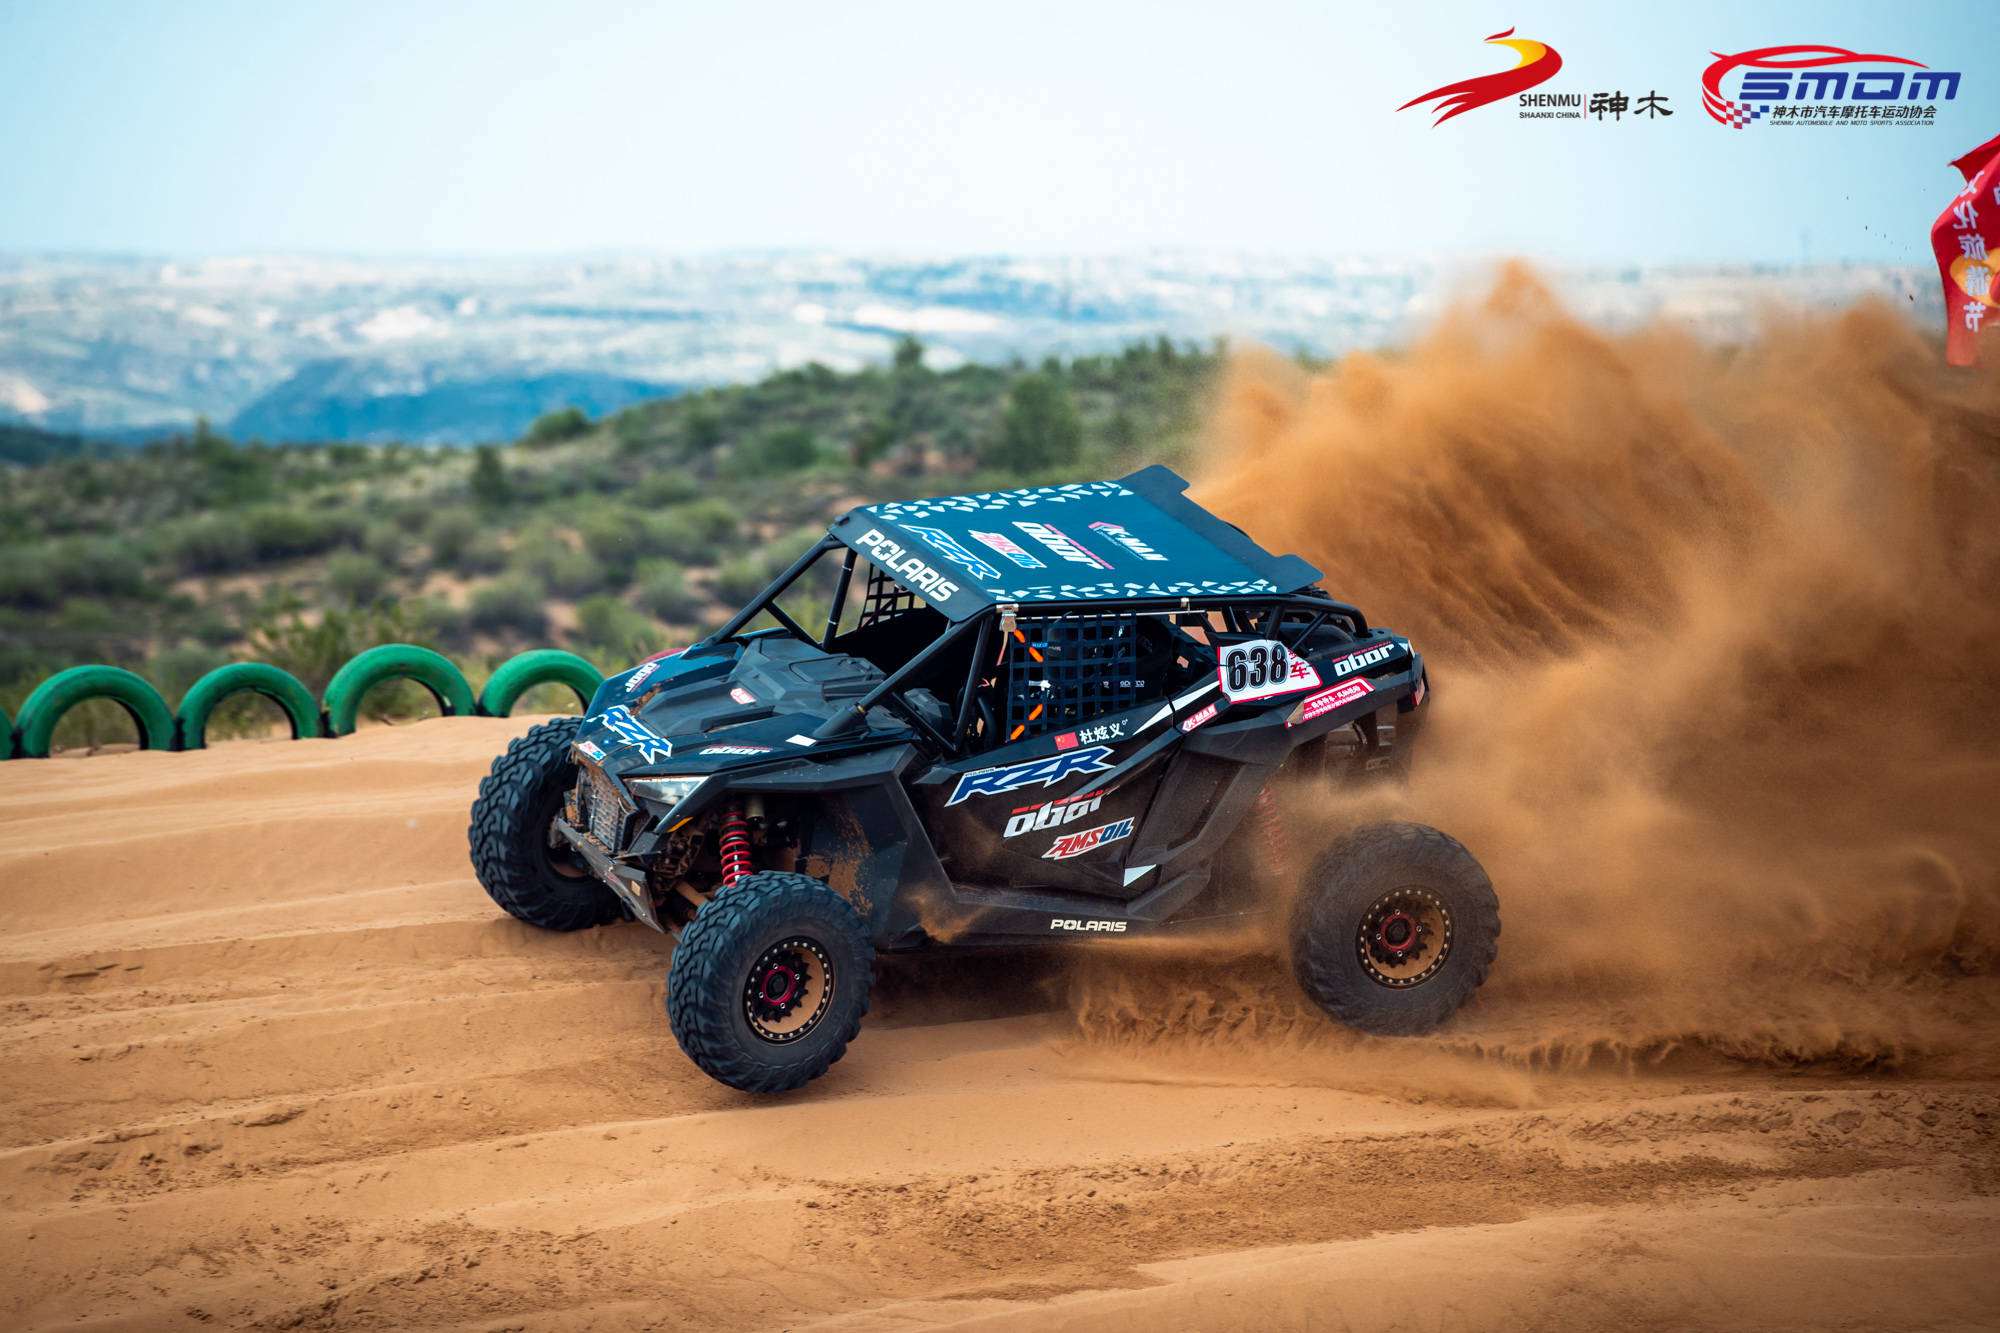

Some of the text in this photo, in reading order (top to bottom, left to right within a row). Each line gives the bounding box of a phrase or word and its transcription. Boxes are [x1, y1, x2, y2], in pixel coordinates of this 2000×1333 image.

[856, 529, 959, 602] POLARIS
[898, 524, 1001, 580] RZR
[1226, 644, 1288, 692] 638
[1334, 643, 1395, 677] obar
[587, 705, 673, 764] RZR
[1079, 722, 1125, 745] 杜炫义
[944, 745, 1116, 807] RZR
[1042, 817, 1134, 860] AMSOIL
[1050, 918, 1127, 932] POLARIS
